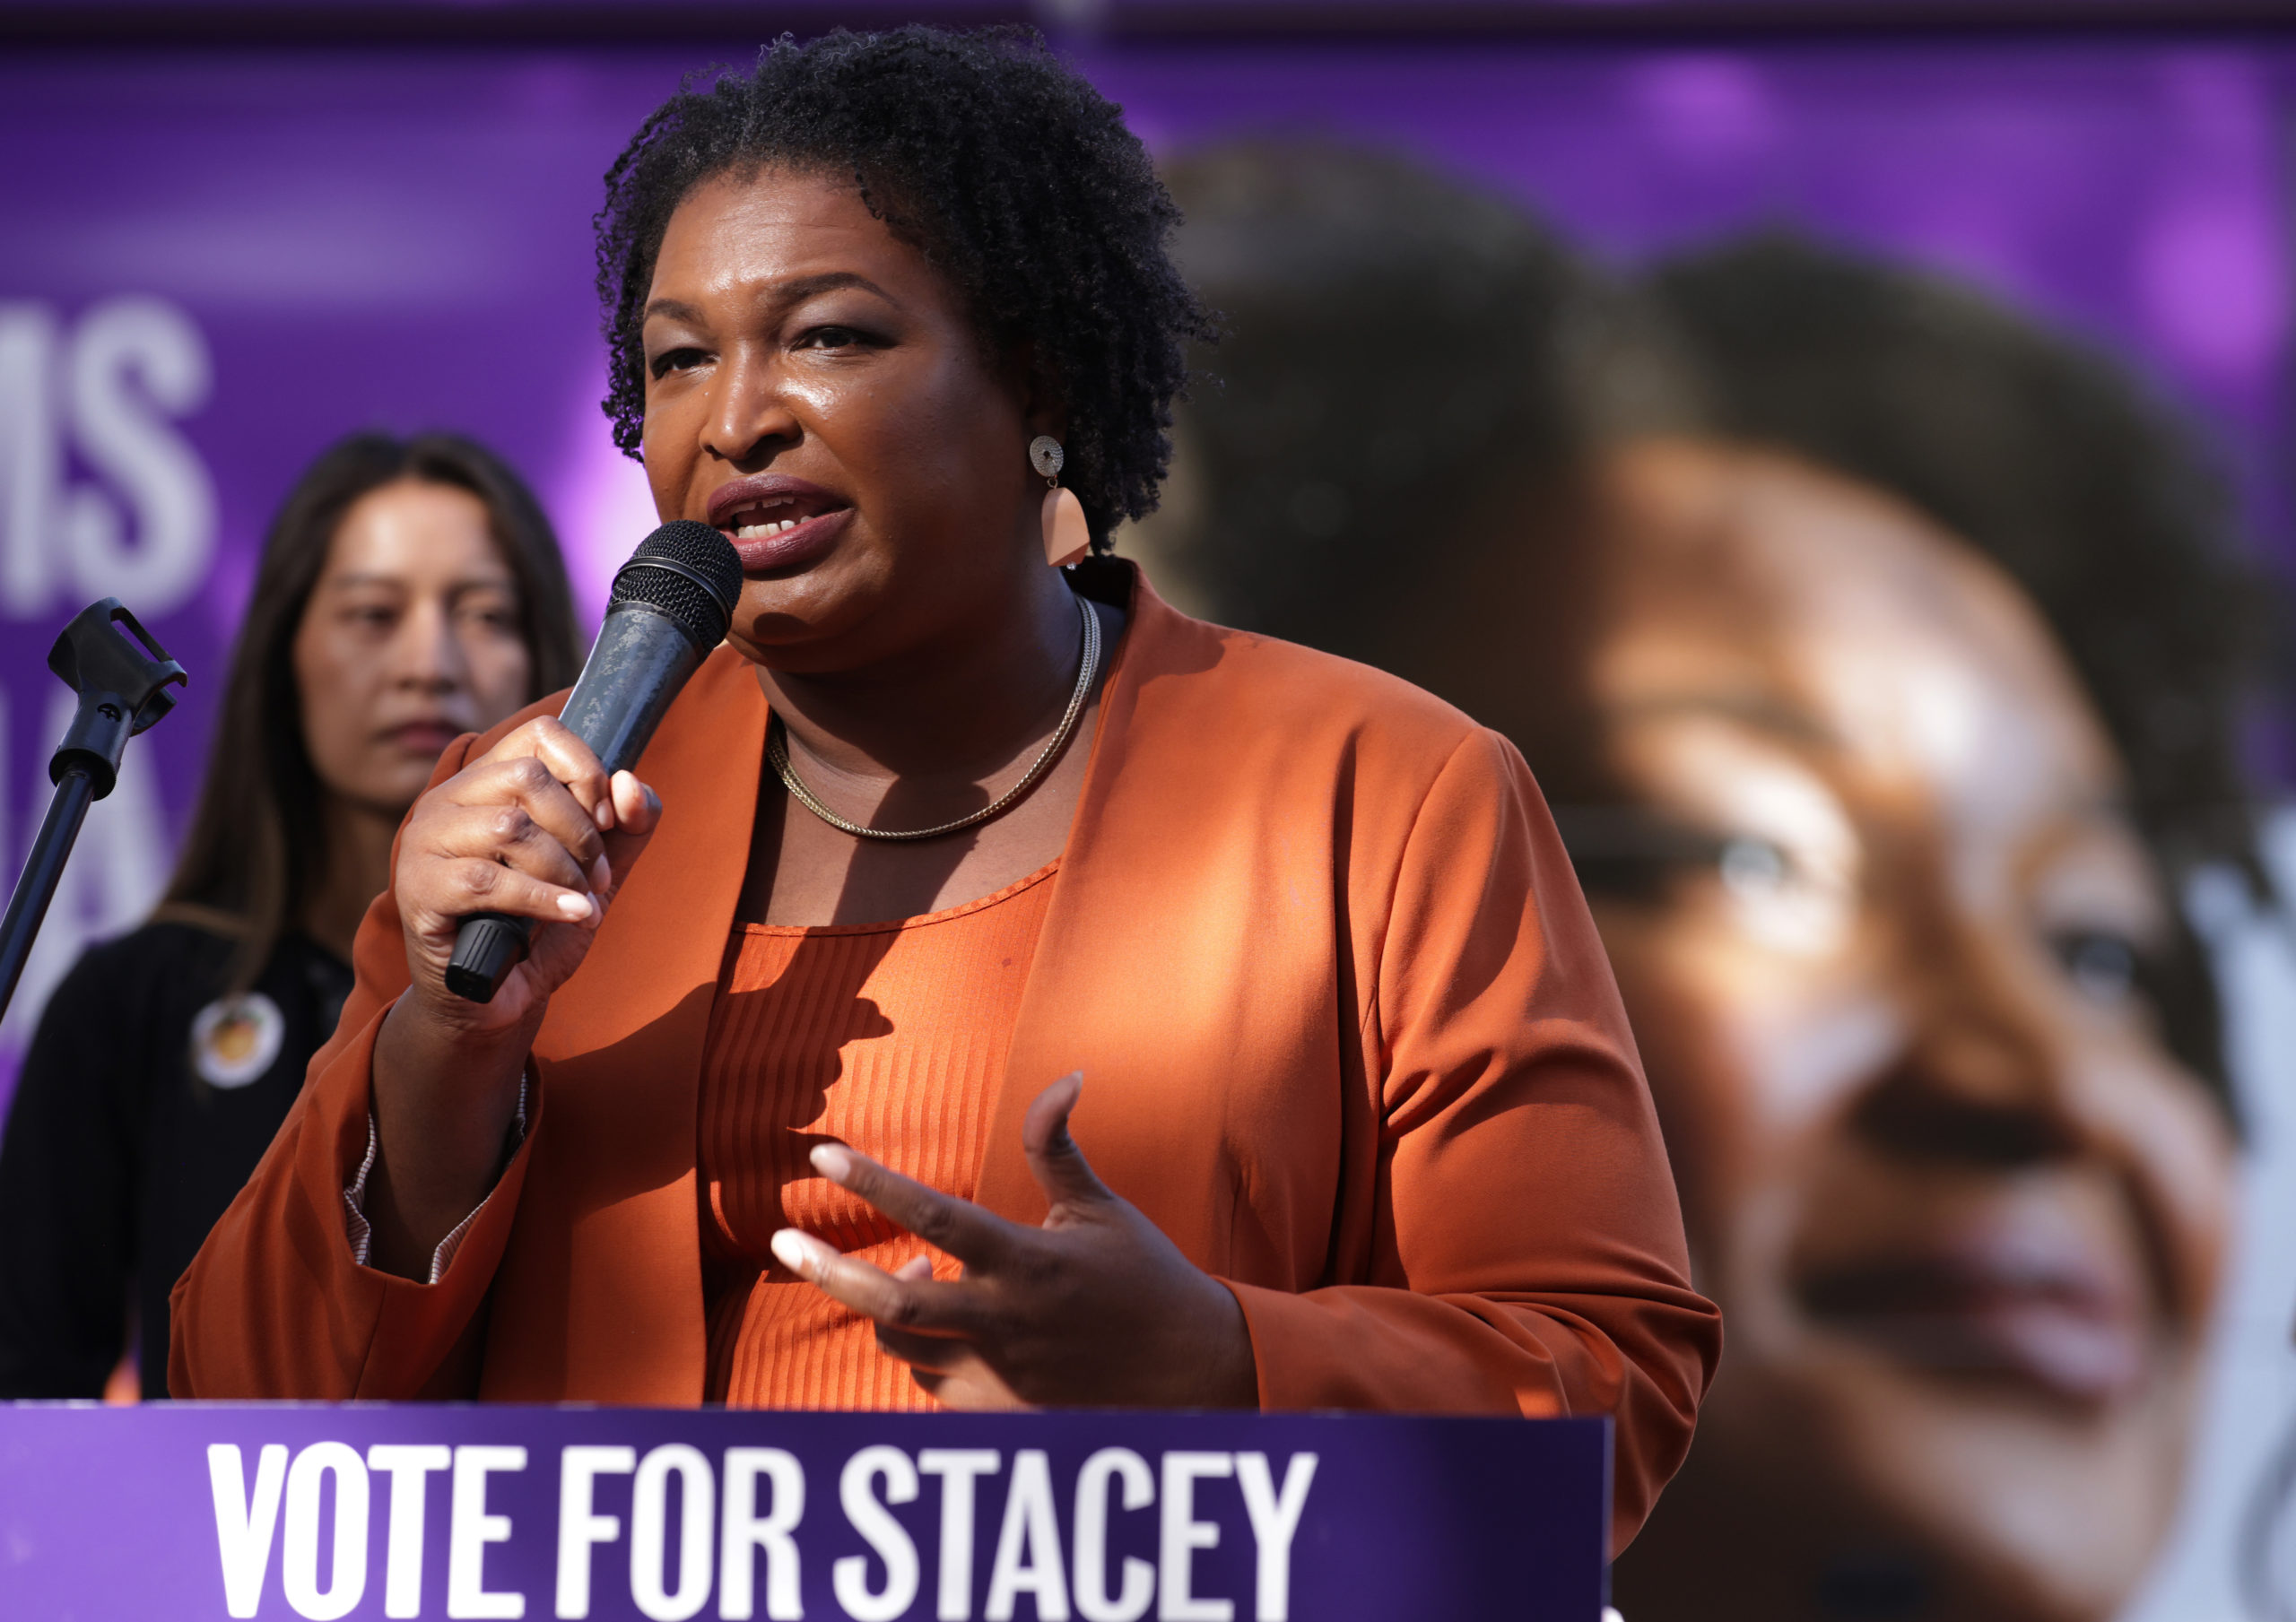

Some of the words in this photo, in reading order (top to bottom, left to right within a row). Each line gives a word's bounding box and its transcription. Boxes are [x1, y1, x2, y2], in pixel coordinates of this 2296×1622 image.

[207, 1441, 528, 1621] VOTE
[555, 1443, 804, 1621] FOR
[833, 1445, 1319, 1622] STACEY
